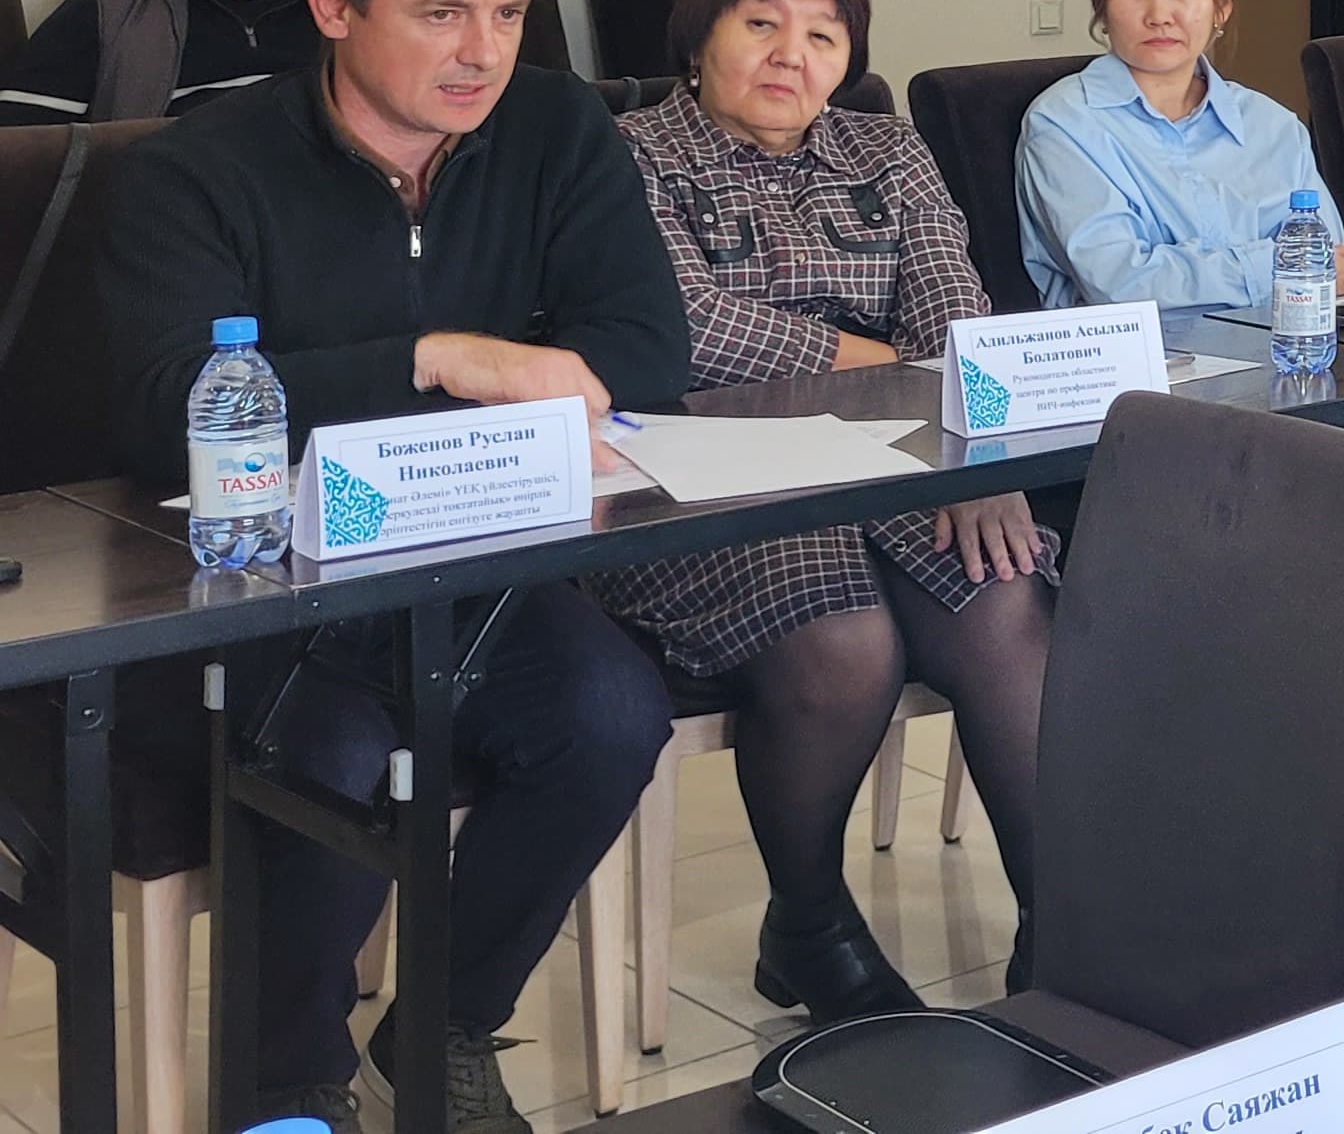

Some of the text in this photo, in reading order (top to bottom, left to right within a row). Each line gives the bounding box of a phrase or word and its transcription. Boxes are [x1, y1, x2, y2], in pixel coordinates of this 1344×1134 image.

[976, 320, 1140, 350] Адильжанов Асылхан
[1022, 346, 1102, 365] Болатович
[377, 426, 536, 459] Боженов Руслан
[217, 468, 284, 494] TASSAY
[399, 453, 520, 482] Николаевич
[385, 504, 441, 523] еркулезді
[1202, 1073, 1322, 1133] Саяжан
